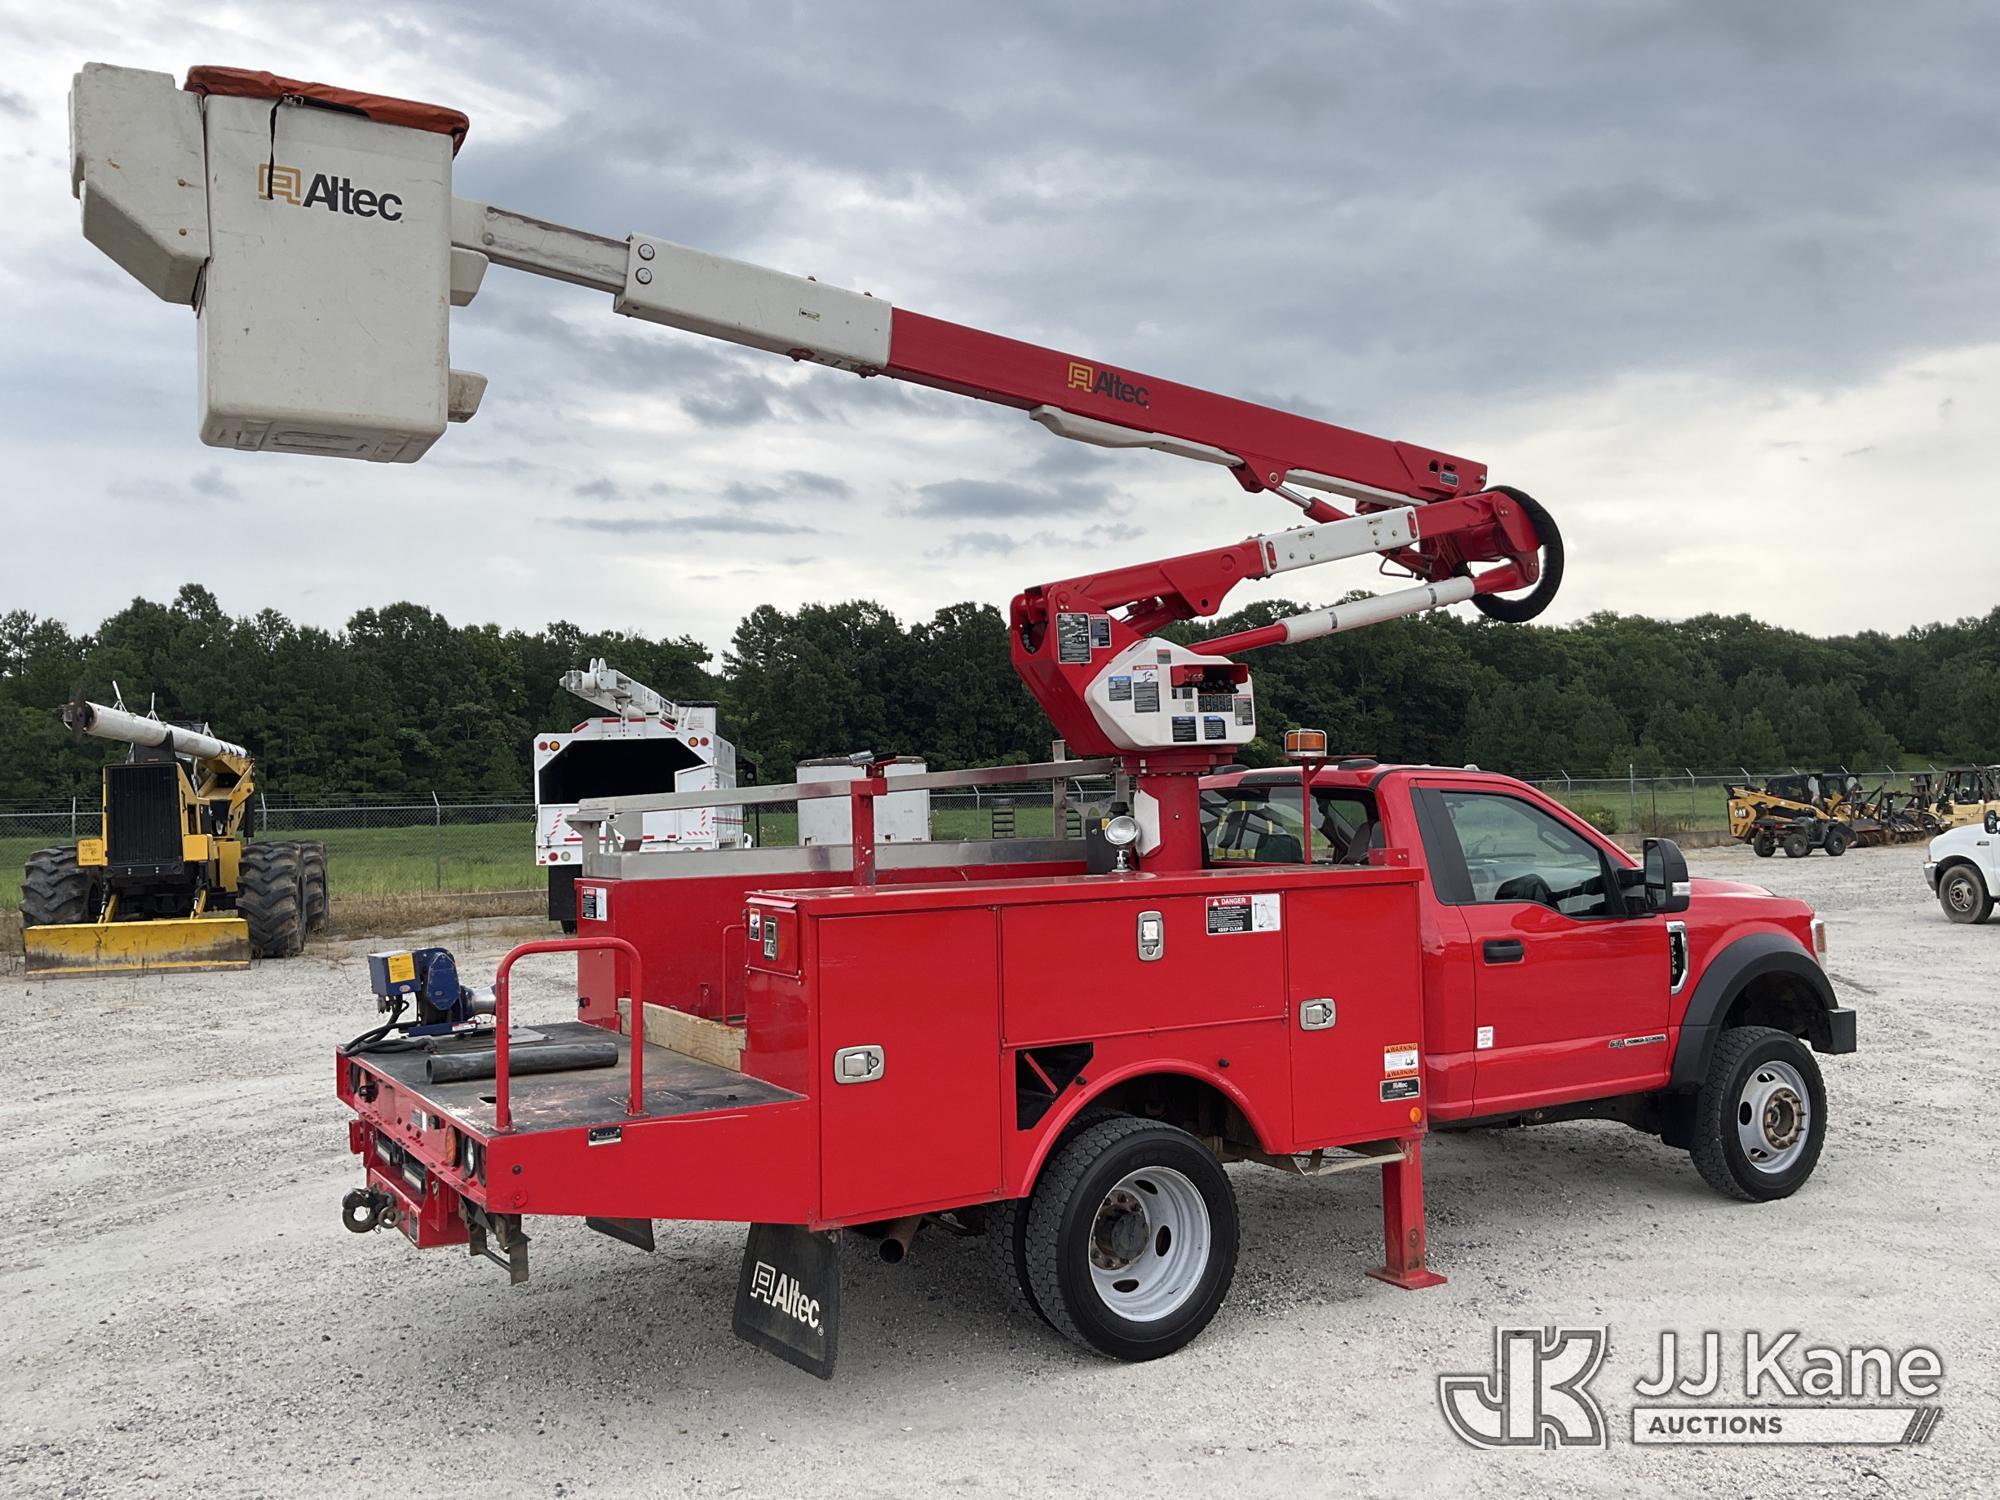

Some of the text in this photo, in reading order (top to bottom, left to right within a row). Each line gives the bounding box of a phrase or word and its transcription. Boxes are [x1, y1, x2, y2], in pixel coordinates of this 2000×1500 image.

[302, 173, 403, 222] Altec
[1093, 370, 1149, 407] Altec
[1734, 808, 1747, 818] CAT
[1221, 897, 1246, 905] DANGER
[1390, 1043, 1417, 1053] WARNING
[1391, 1068, 1418, 1078] WARNING
[771, 1272, 820, 1329] Altec
